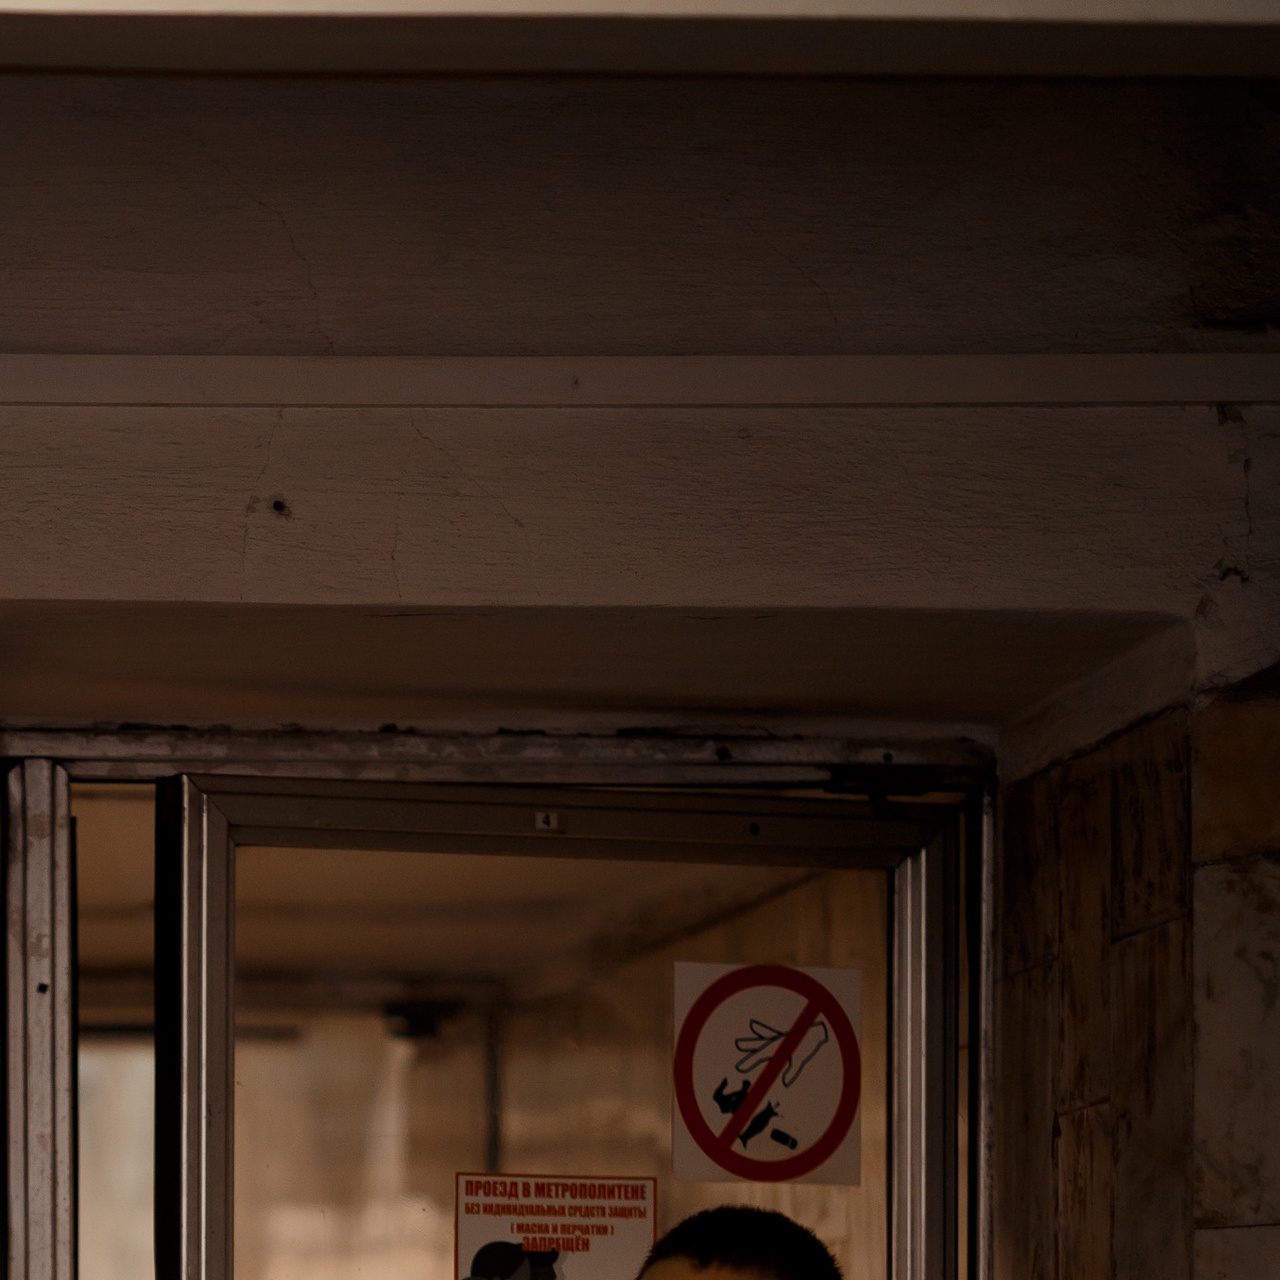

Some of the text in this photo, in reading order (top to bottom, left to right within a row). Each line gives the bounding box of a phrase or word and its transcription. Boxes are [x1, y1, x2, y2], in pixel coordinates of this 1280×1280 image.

[465, 1180, 647, 1201] ПРОЕЗД В МЕТРОПОЛИТЕНЕ
[465, 1203, 647, 1219] БЕЗ ИНДИВИДУАЛЬНЫХ СРЕДСТВ ЗАЩИТЫ
[517, 1223, 550, 1234] МАСКА
[552, 1224, 559, 1235] И
[560, 1224, 608, 1236] ПЕРЧАТКИ
